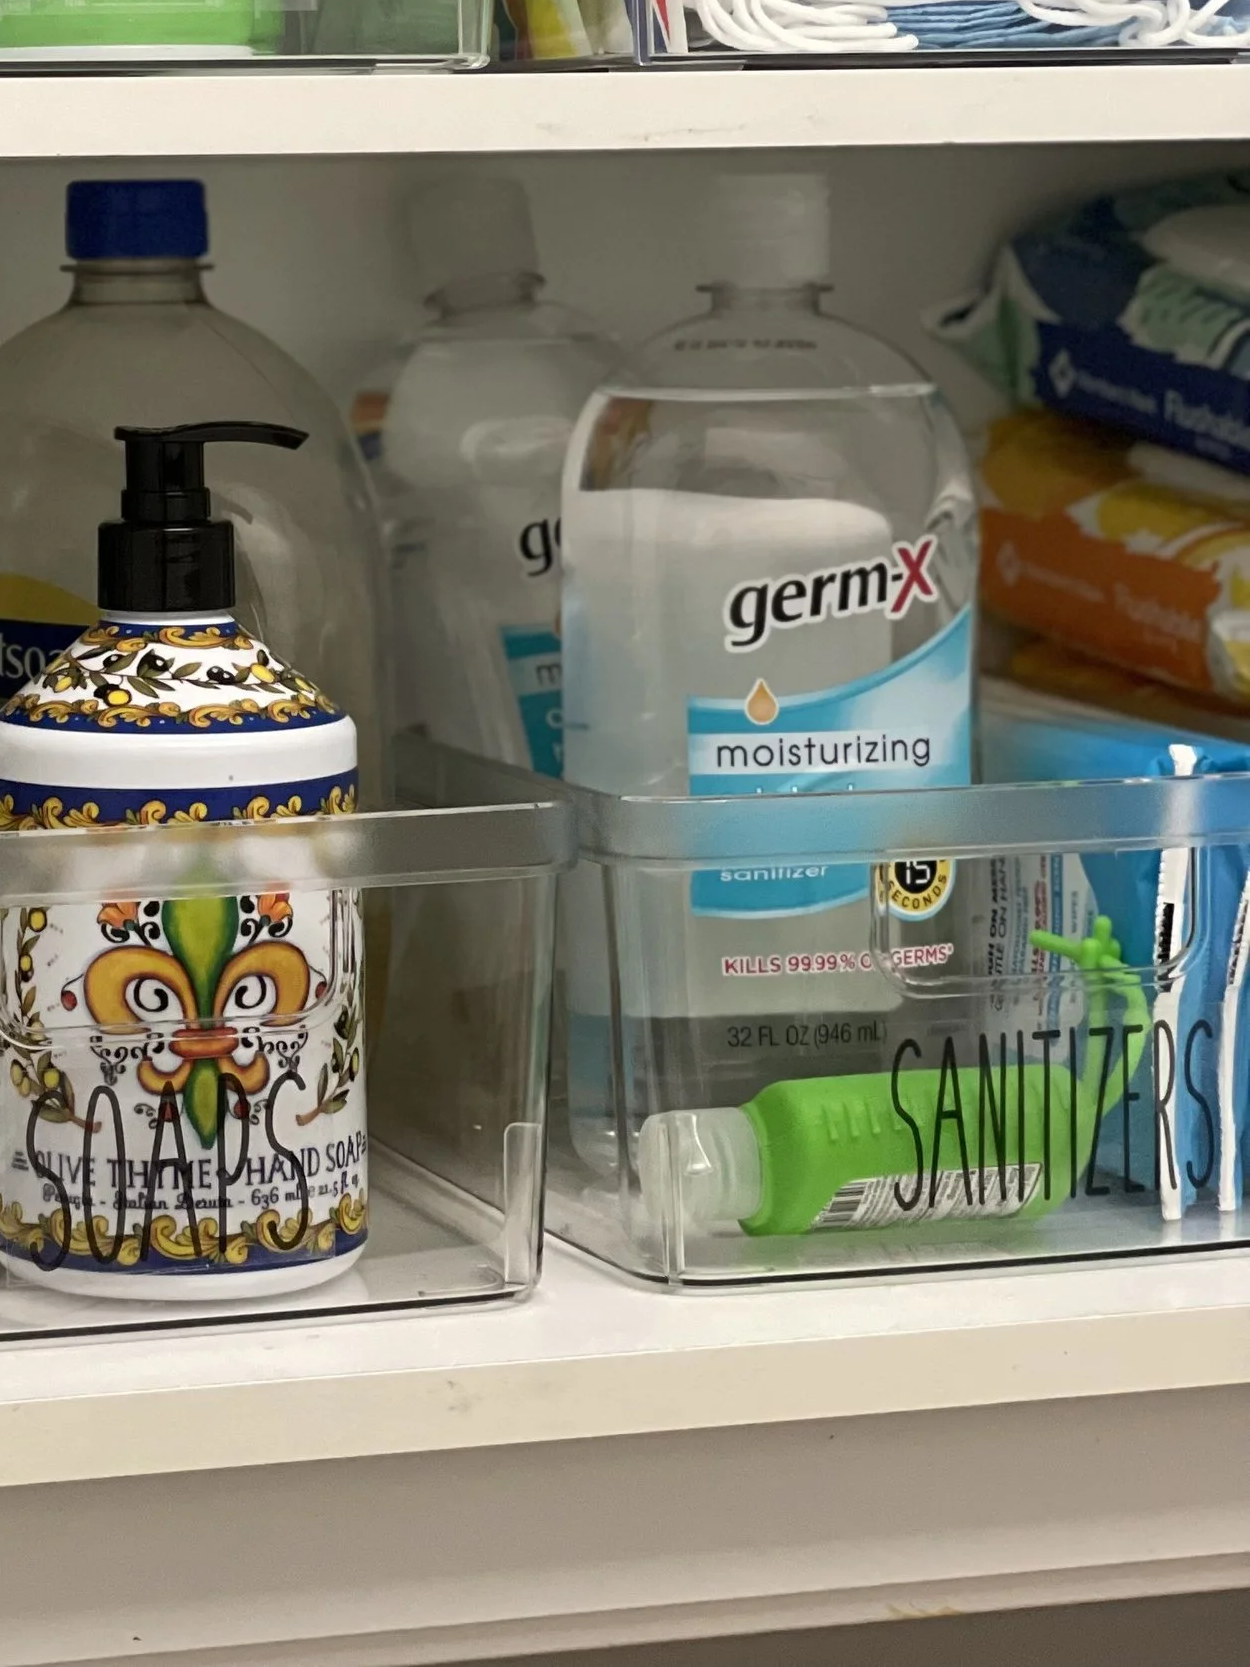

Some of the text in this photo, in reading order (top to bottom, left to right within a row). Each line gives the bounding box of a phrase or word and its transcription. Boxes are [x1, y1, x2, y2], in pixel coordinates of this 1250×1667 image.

[717, 734, 930, 767] moisturizing
[720, 864, 828, 882] sanitizer
[724, 957, 781, 974] KILLS
[788, 952, 855, 972] 99.99%
[727, 1027, 750, 1047] 32
[758, 1026, 780, 1046] FL
[786, 1026, 808, 1046] OZ
[814, 1024, 850, 1049] (946
[891, 1019, 1216, 1212] SANITIZERS
[27, 1071, 306, 1271] SOAPS
[35, 1150, 95, 1186] OLIVE
[246, 1147, 320, 1185] HAND
[326, 1130, 361, 1172] SOAP
[251, 1187, 279, 1209] 636
